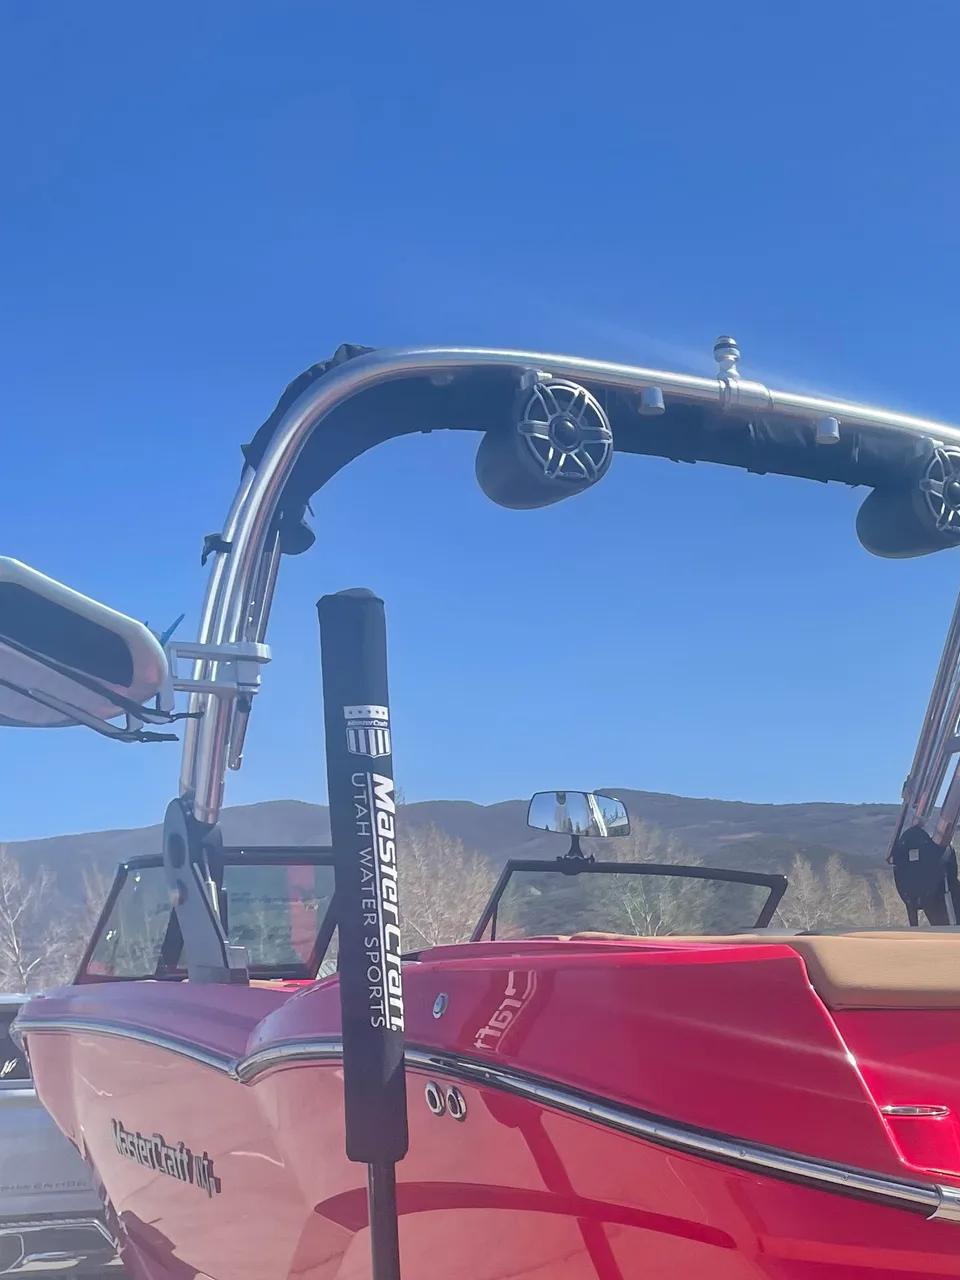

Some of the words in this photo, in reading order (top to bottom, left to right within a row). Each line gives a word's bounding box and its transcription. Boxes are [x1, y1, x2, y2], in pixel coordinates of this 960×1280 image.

[351, 772, 369, 837] UTAH
[357, 847, 377, 927] WATER
[371, 772, 405, 1032] MasterCraft
[364, 937, 386, 1028] SPORTS
[110, 1117, 194, 1185] MasterCraft
